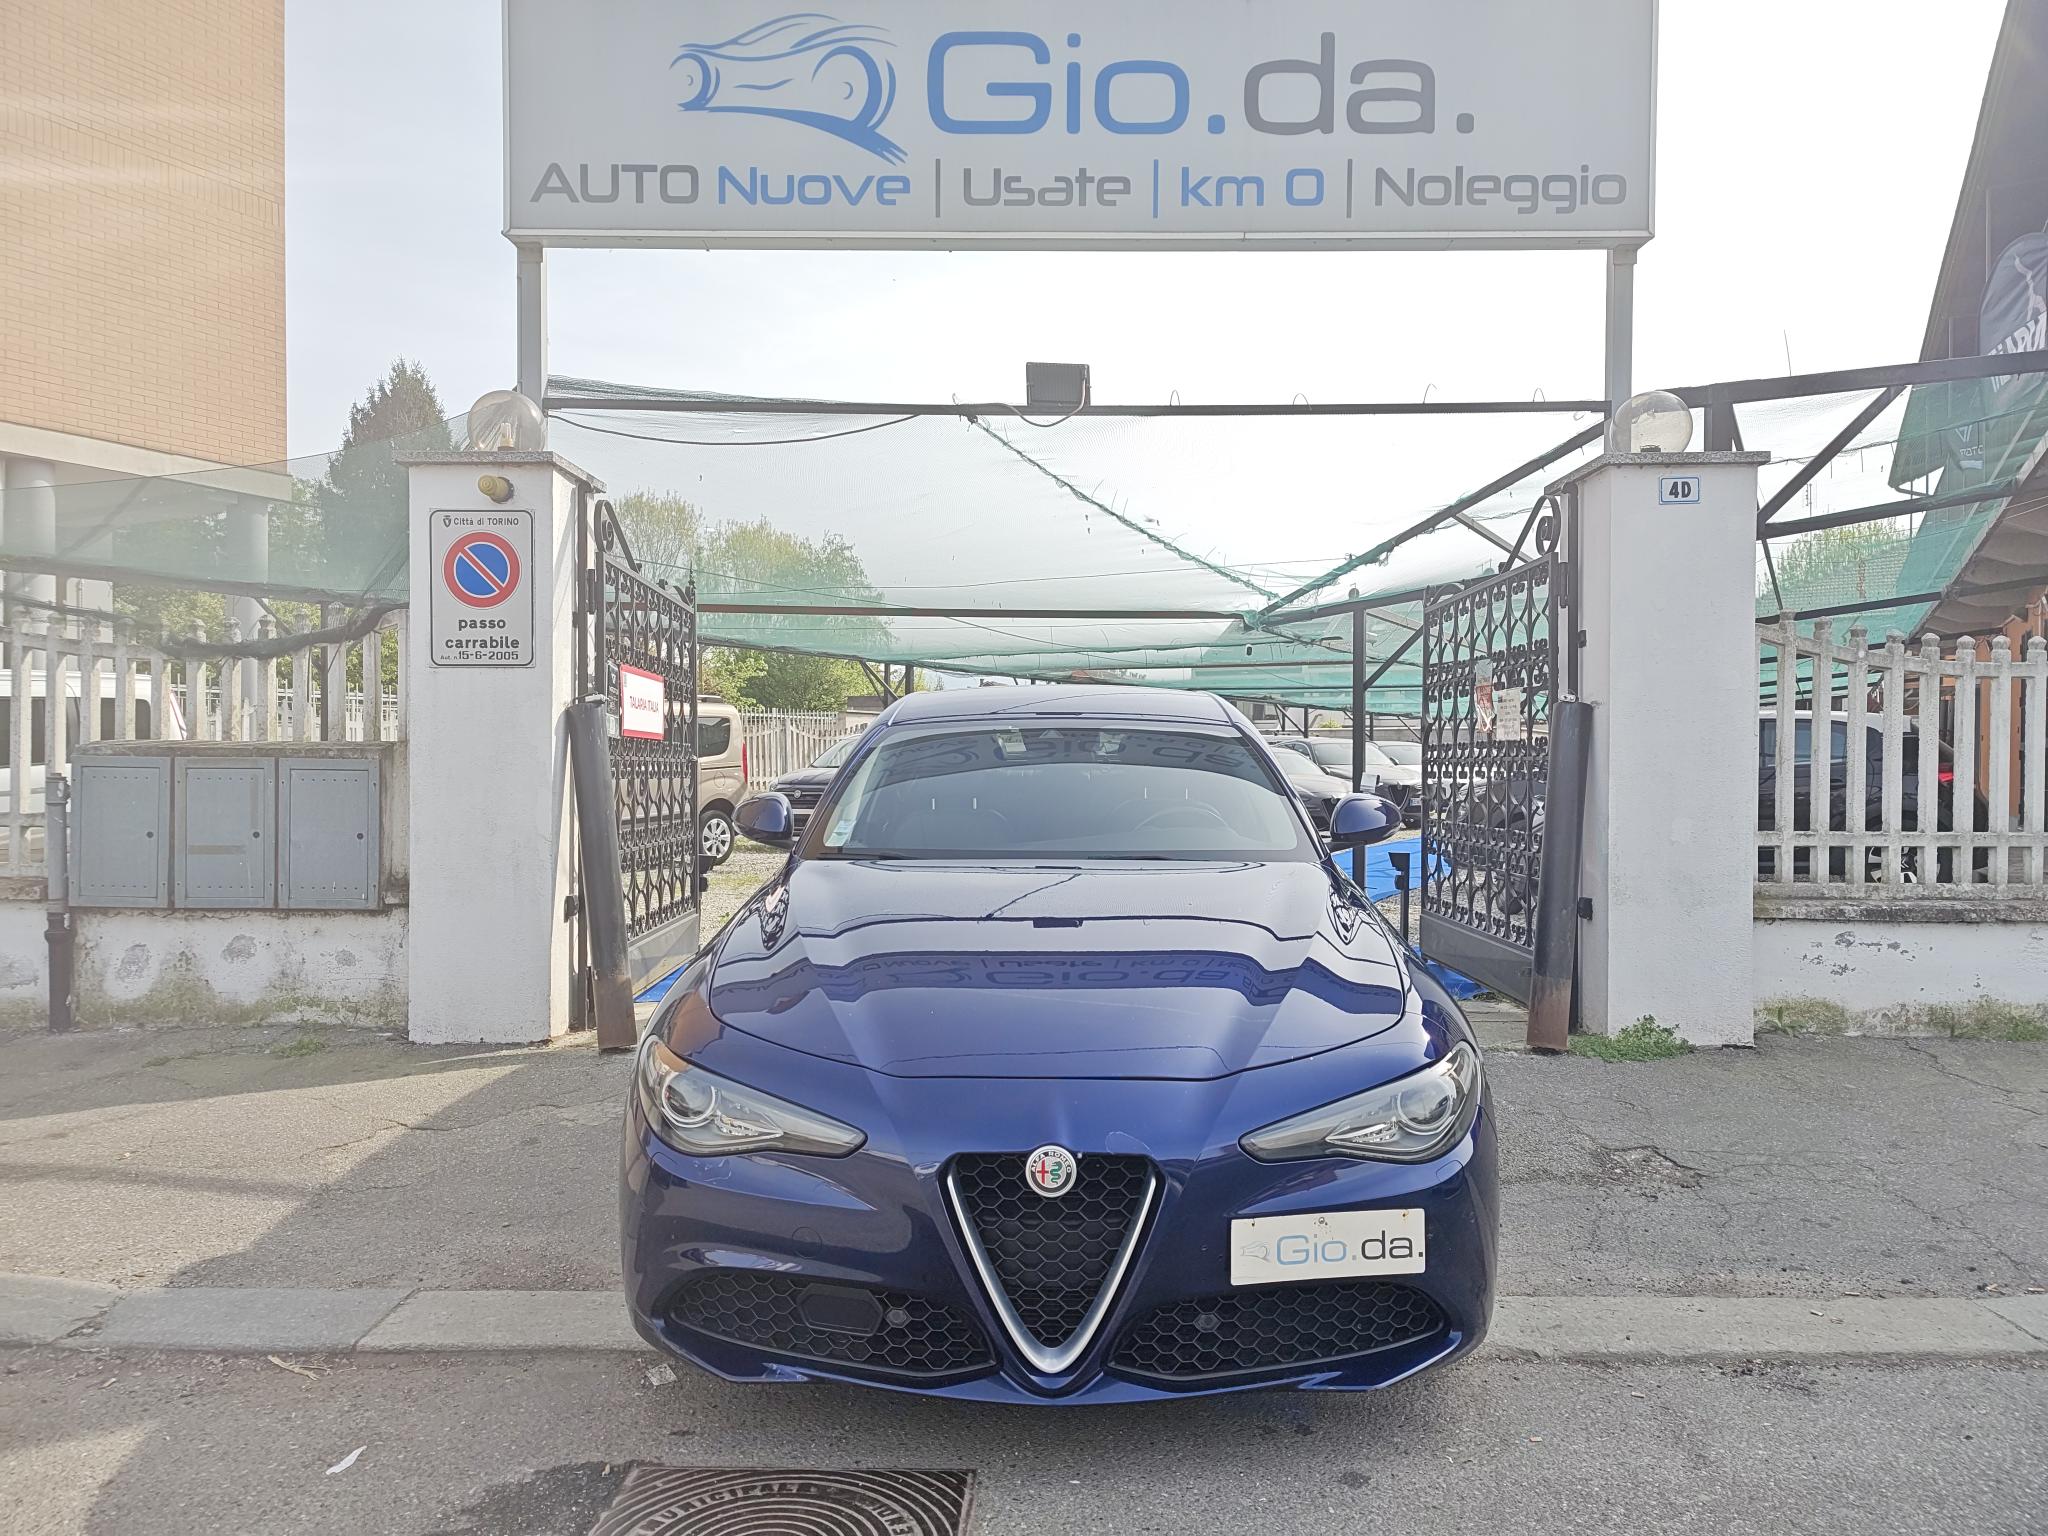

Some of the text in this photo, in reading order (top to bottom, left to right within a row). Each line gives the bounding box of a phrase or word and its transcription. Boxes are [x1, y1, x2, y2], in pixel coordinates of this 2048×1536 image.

[927, 31, 1475, 136] Gio.da.
[530, 162, 700, 204] AUTO
[717, 165, 911, 206] Nuove
[962, 166, 1131, 207] Usate
[1180, 166, 1265, 207] km
[1374, 164, 1628, 215] Noleggio
[1669, 481, 1692, 498] 4D
[477, 517, 485, 526] di
[487, 517, 519, 526] TORINO
[458, 619, 506, 631] passo
[445, 636, 520, 649] carrabile
[459, 650, 519, 660] 15-6-2005
[1031, 1151, 1072, 1173] ALFA ROMEO
[1276, 1230, 1424, 1266] Gio.da.
